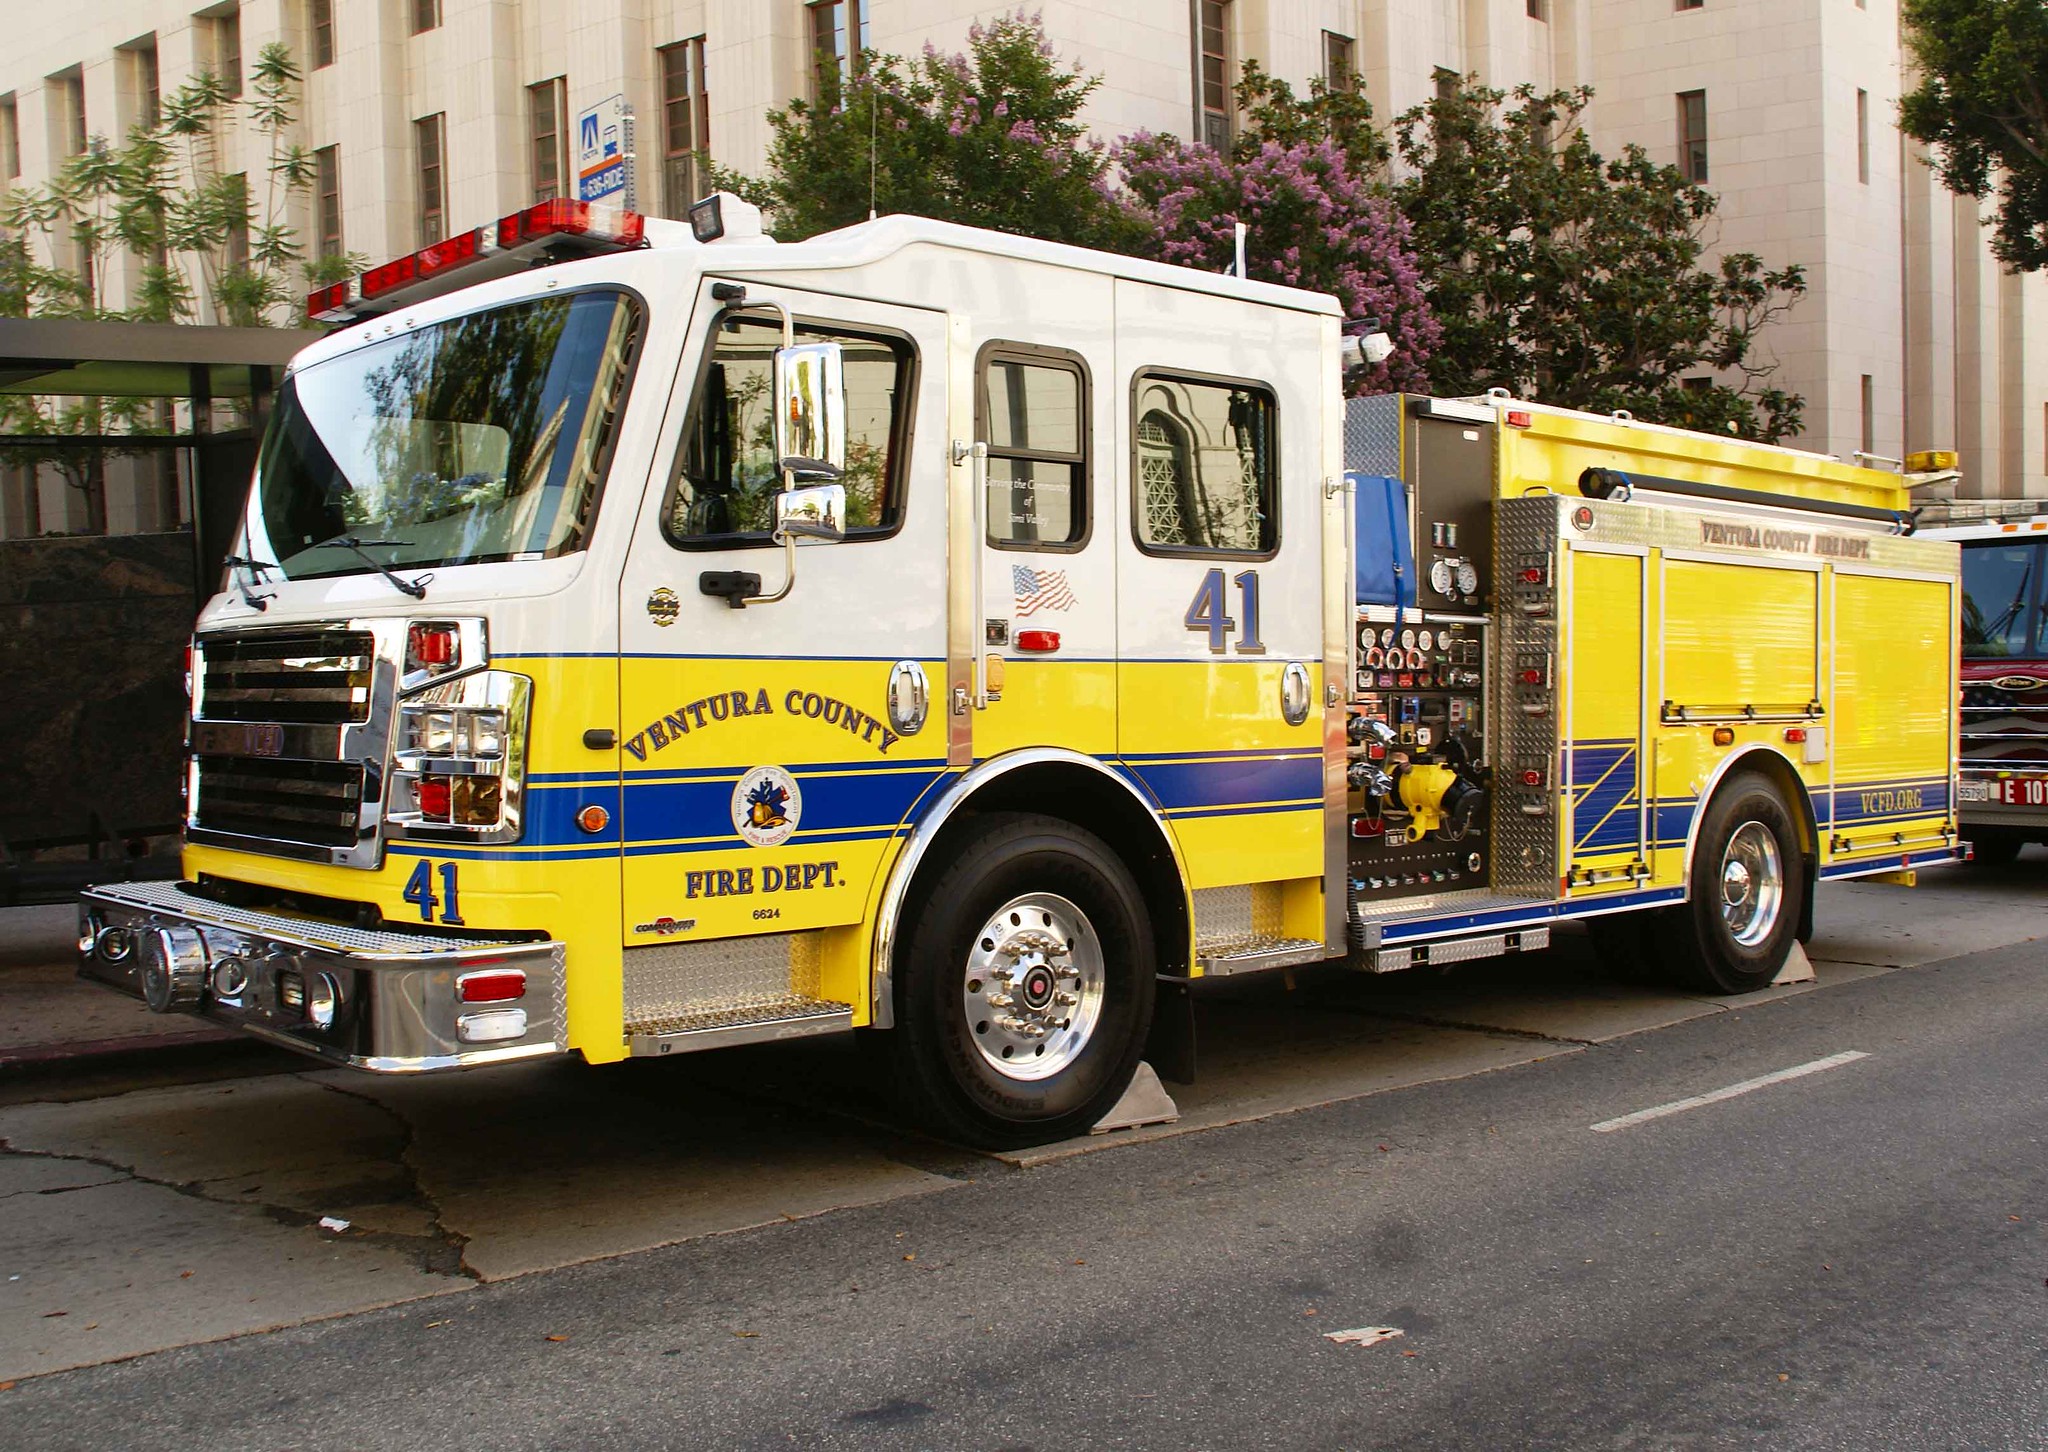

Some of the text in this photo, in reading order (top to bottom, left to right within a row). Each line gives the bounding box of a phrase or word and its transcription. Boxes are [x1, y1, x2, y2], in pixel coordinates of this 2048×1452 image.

[1014, 478, 1027, 489] the
[1023, 495, 1035, 508] of
[1701, 519, 1761, 549] VENTURA
[1762, 528, 1811, 554] COUNTY
[1814, 533, 1840, 556] FIRE
[1184, 567, 1266, 655] 41
[623, 688, 900, 762] VENTURA COUNTY
[1860, 788, 1922, 815] VCFD.ORG
[2005, 780, 2015, 803] E
[402, 858, 465, 926] 41
[685, 861, 846, 898] FIRE DEPT.
[752, 908, 780, 920] 6624
